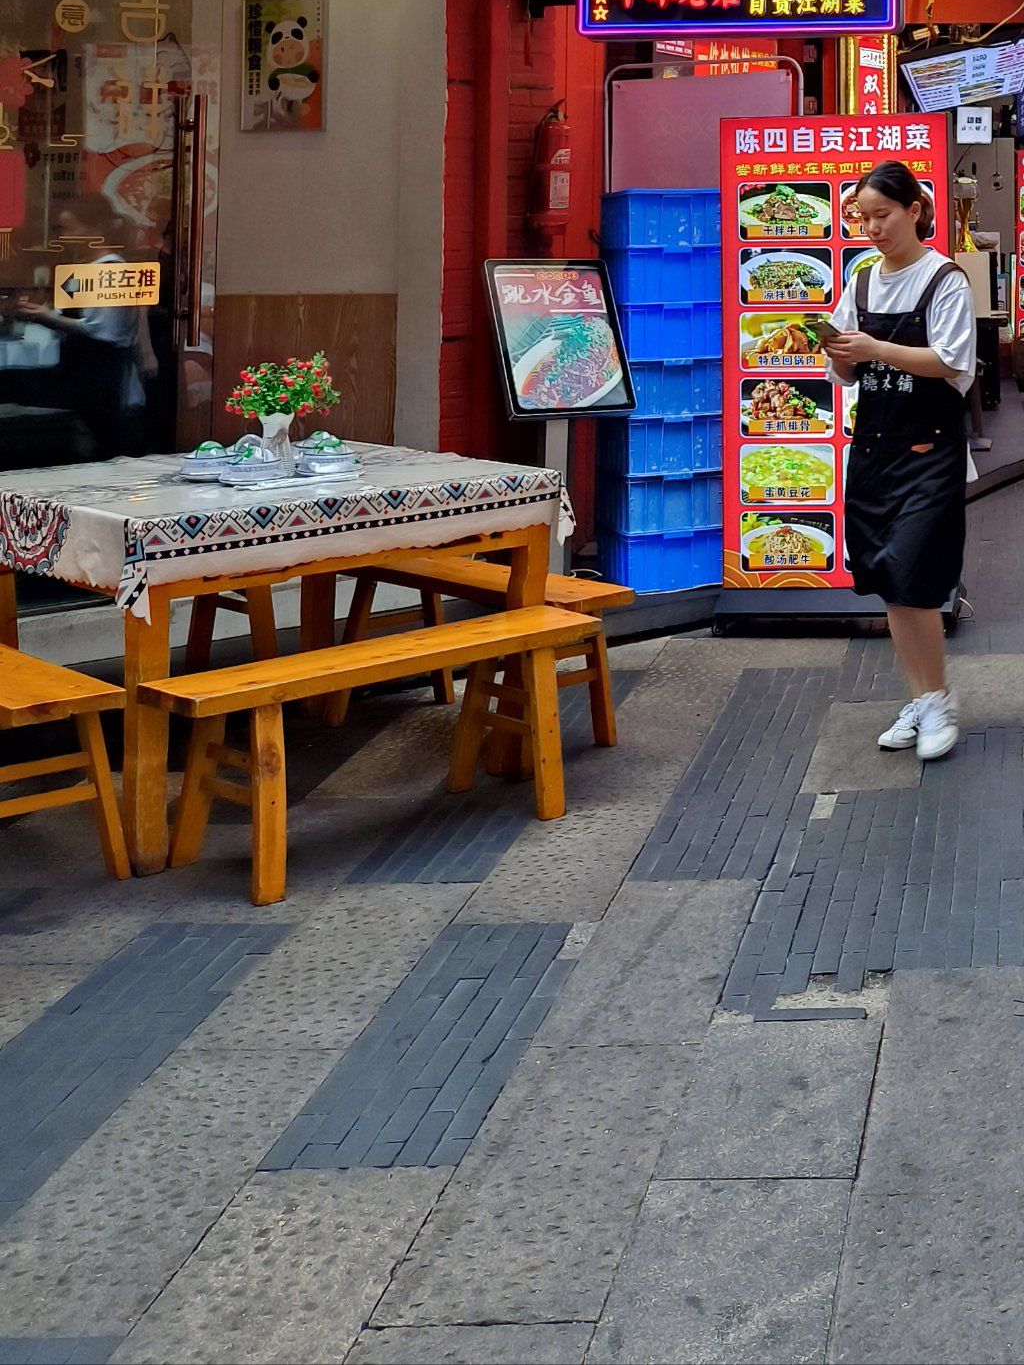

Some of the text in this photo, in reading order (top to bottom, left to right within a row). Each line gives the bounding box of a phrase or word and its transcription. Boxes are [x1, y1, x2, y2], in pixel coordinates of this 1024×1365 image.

[735, 123, 932, 155] 陈四自贡江湖菜
[735, 160, 933, 177] 尝新鲜就在陈四!巴板!
[763, 224, 809, 237] 干拌牛肉
[97, 268, 156, 290] 往左推
[97, 290, 154, 301] PUSH LEFT
[758, 355, 816, 367] 特色回锅肉
